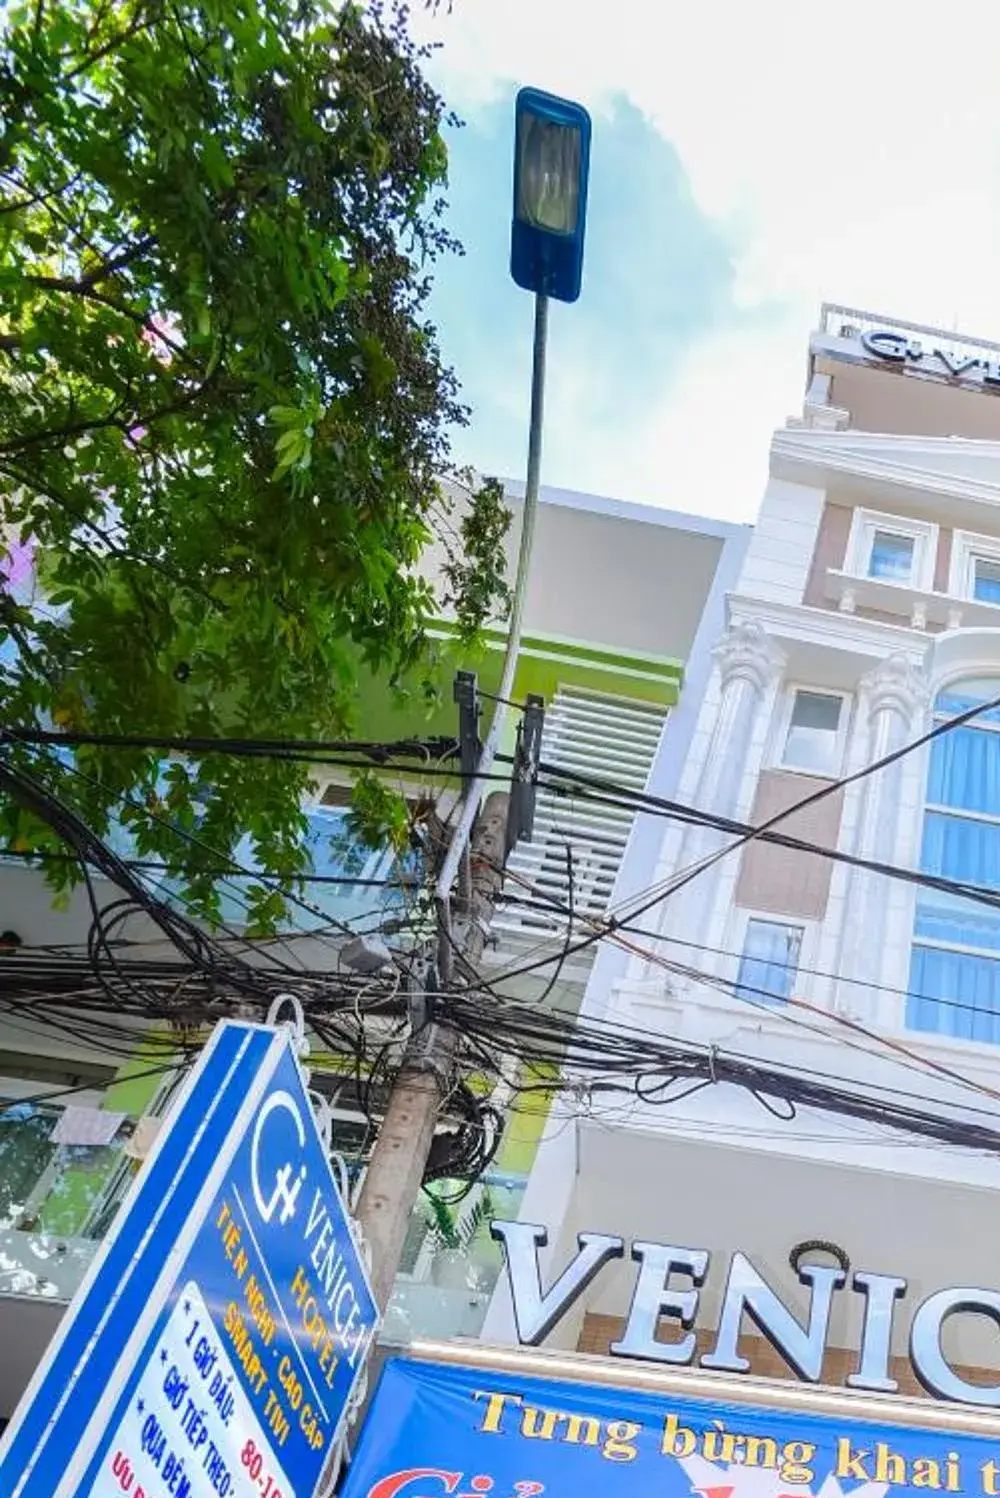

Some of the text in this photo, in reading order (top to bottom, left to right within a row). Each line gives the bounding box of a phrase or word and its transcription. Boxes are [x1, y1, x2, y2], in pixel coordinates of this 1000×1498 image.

[290, 1264, 339, 1390] HOTEL
[223, 1302, 290, 1446] SMART TIVI
[277, 1355, 303, 1411] CAO
[141, 1413, 167, 1468] QUA
[836, 1438, 960, 1493] khai
